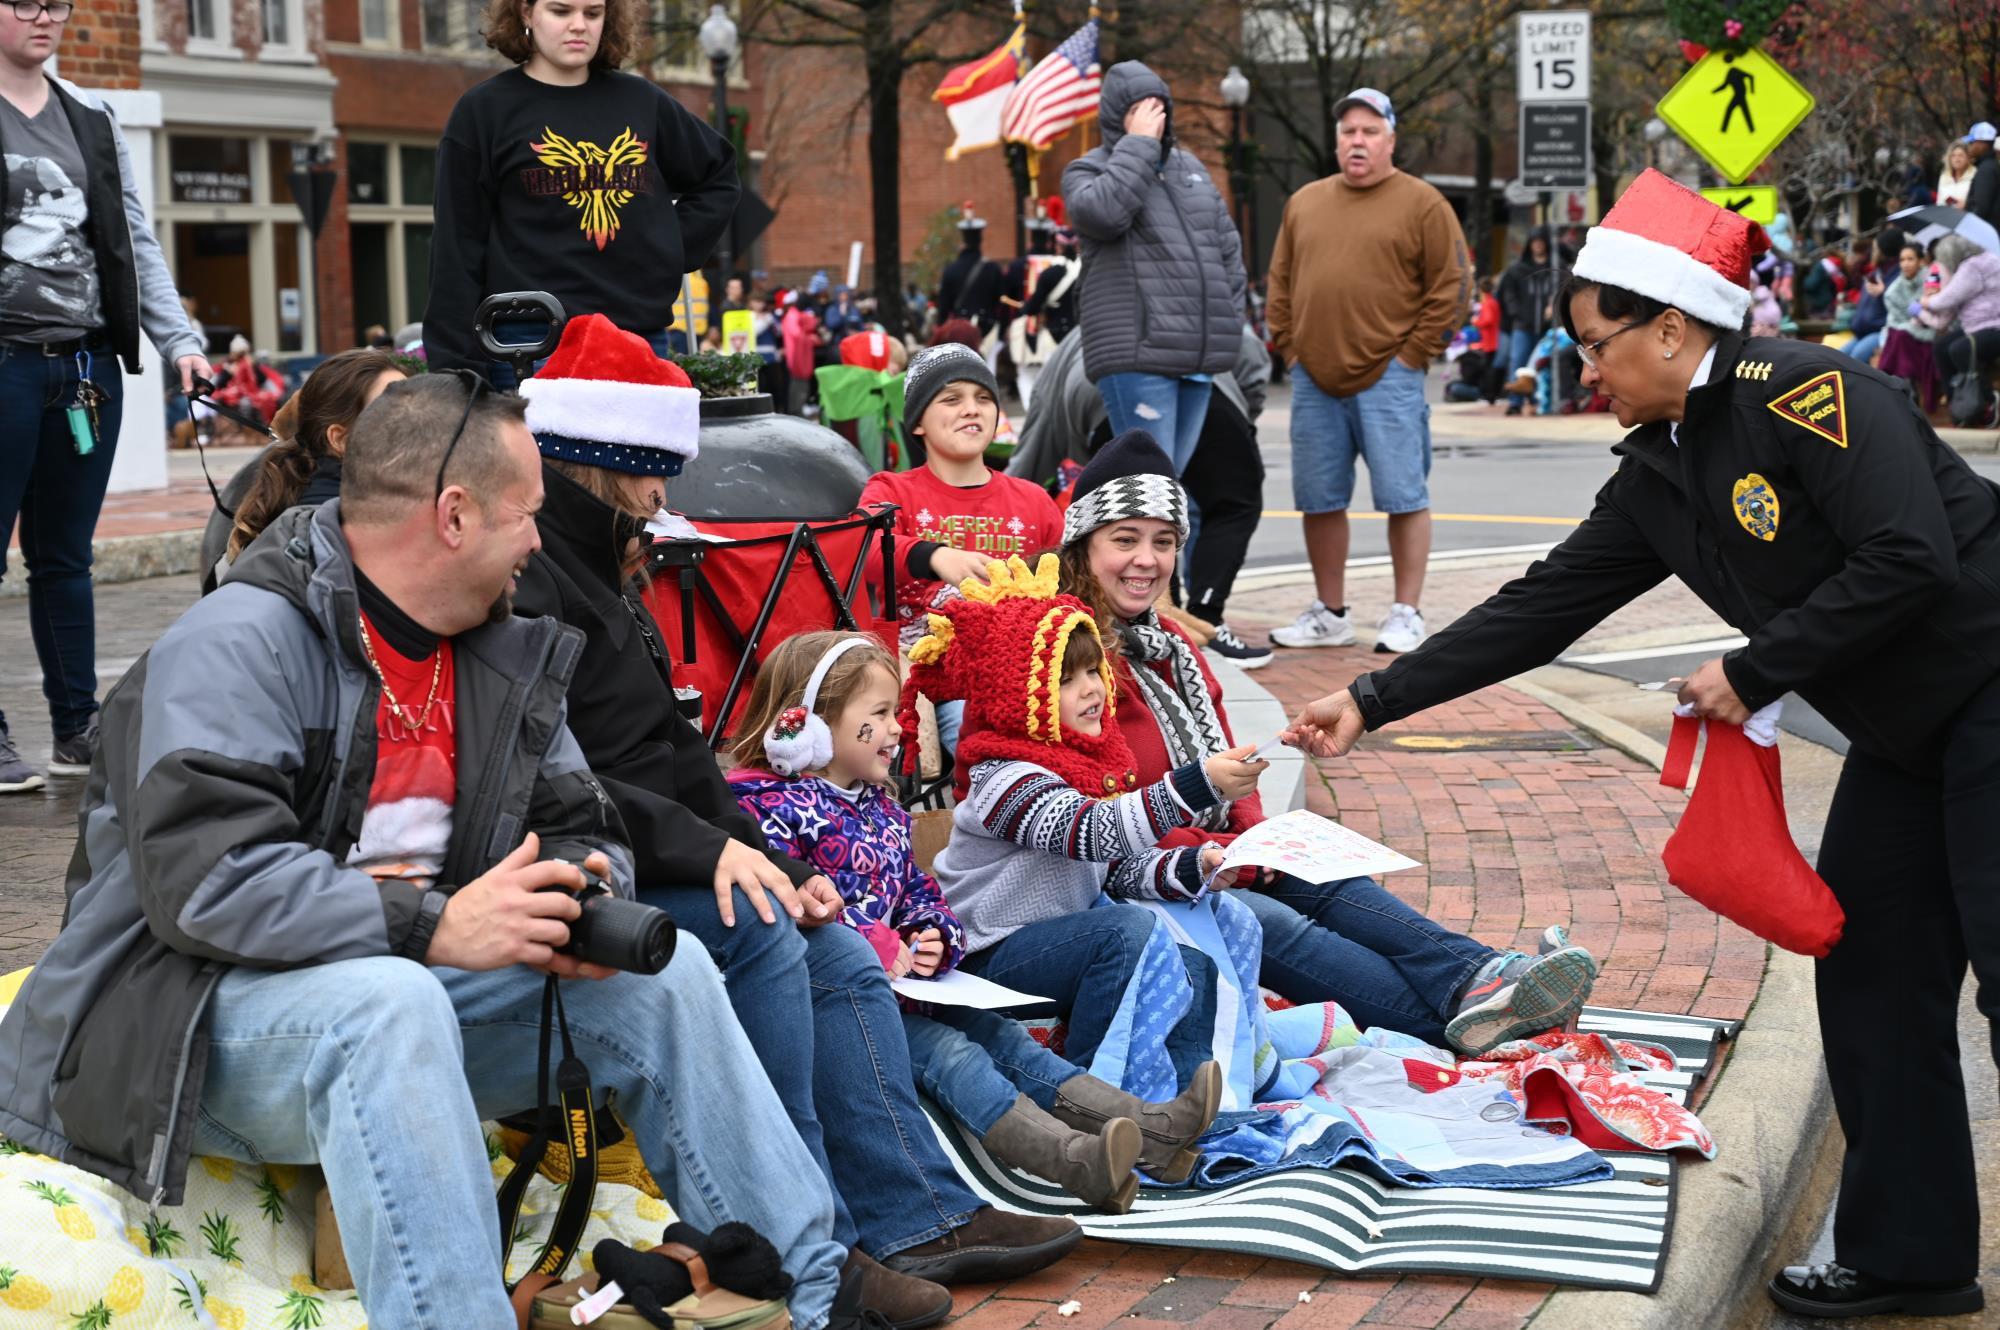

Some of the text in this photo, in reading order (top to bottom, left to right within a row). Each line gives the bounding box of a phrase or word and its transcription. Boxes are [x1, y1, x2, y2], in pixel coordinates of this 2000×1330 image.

[1526, 22, 1585, 37] SPEED
[1531, 40, 1576, 54] LIMIT
[1534, 59, 1576, 90] 15
[1808, 402, 1838, 423] POLICE
[938, 515, 1004, 533] MERRY
[975, 533, 1027, 552] DUDE
[569, 1108, 588, 1159] Nikon
